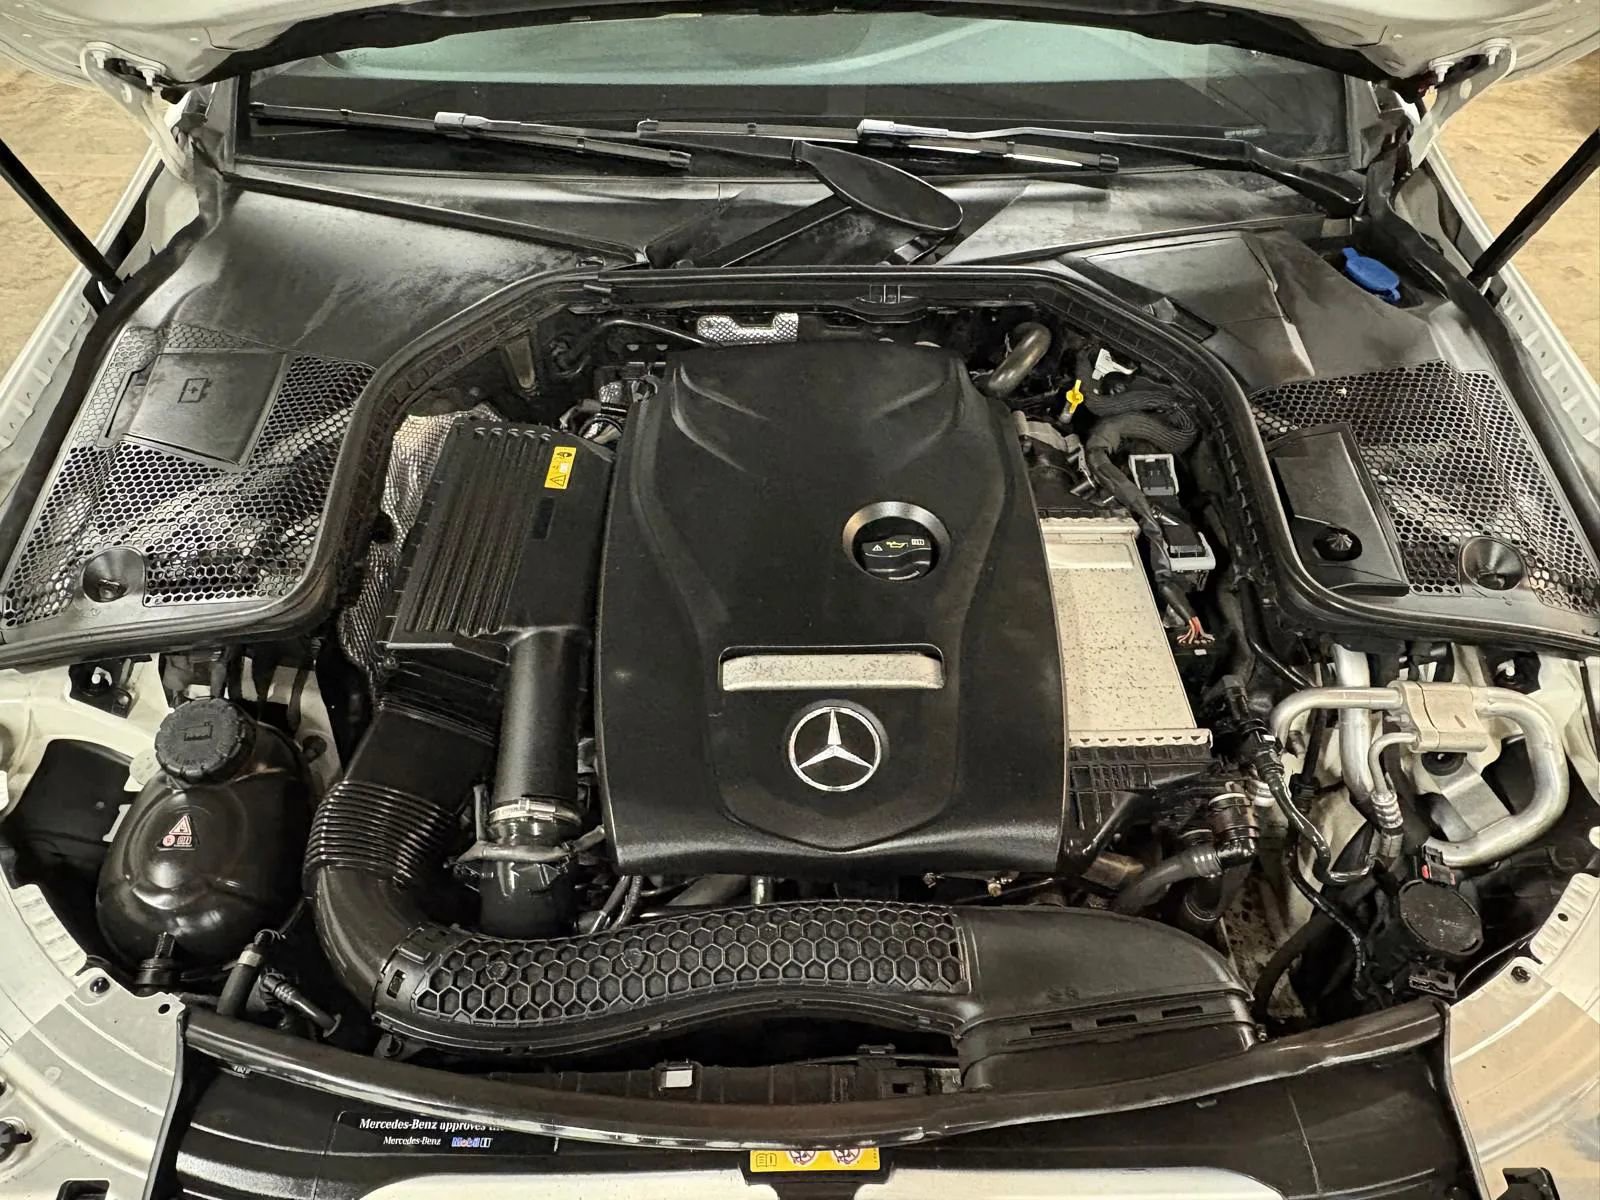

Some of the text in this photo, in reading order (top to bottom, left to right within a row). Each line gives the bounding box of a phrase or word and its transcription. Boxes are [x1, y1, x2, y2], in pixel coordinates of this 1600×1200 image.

[359, 1118, 438, 1130] Mercedes-Benz
[440, 1121, 486, 1132] approves
[383, 1136, 442, 1146] Mercedes-Benz
